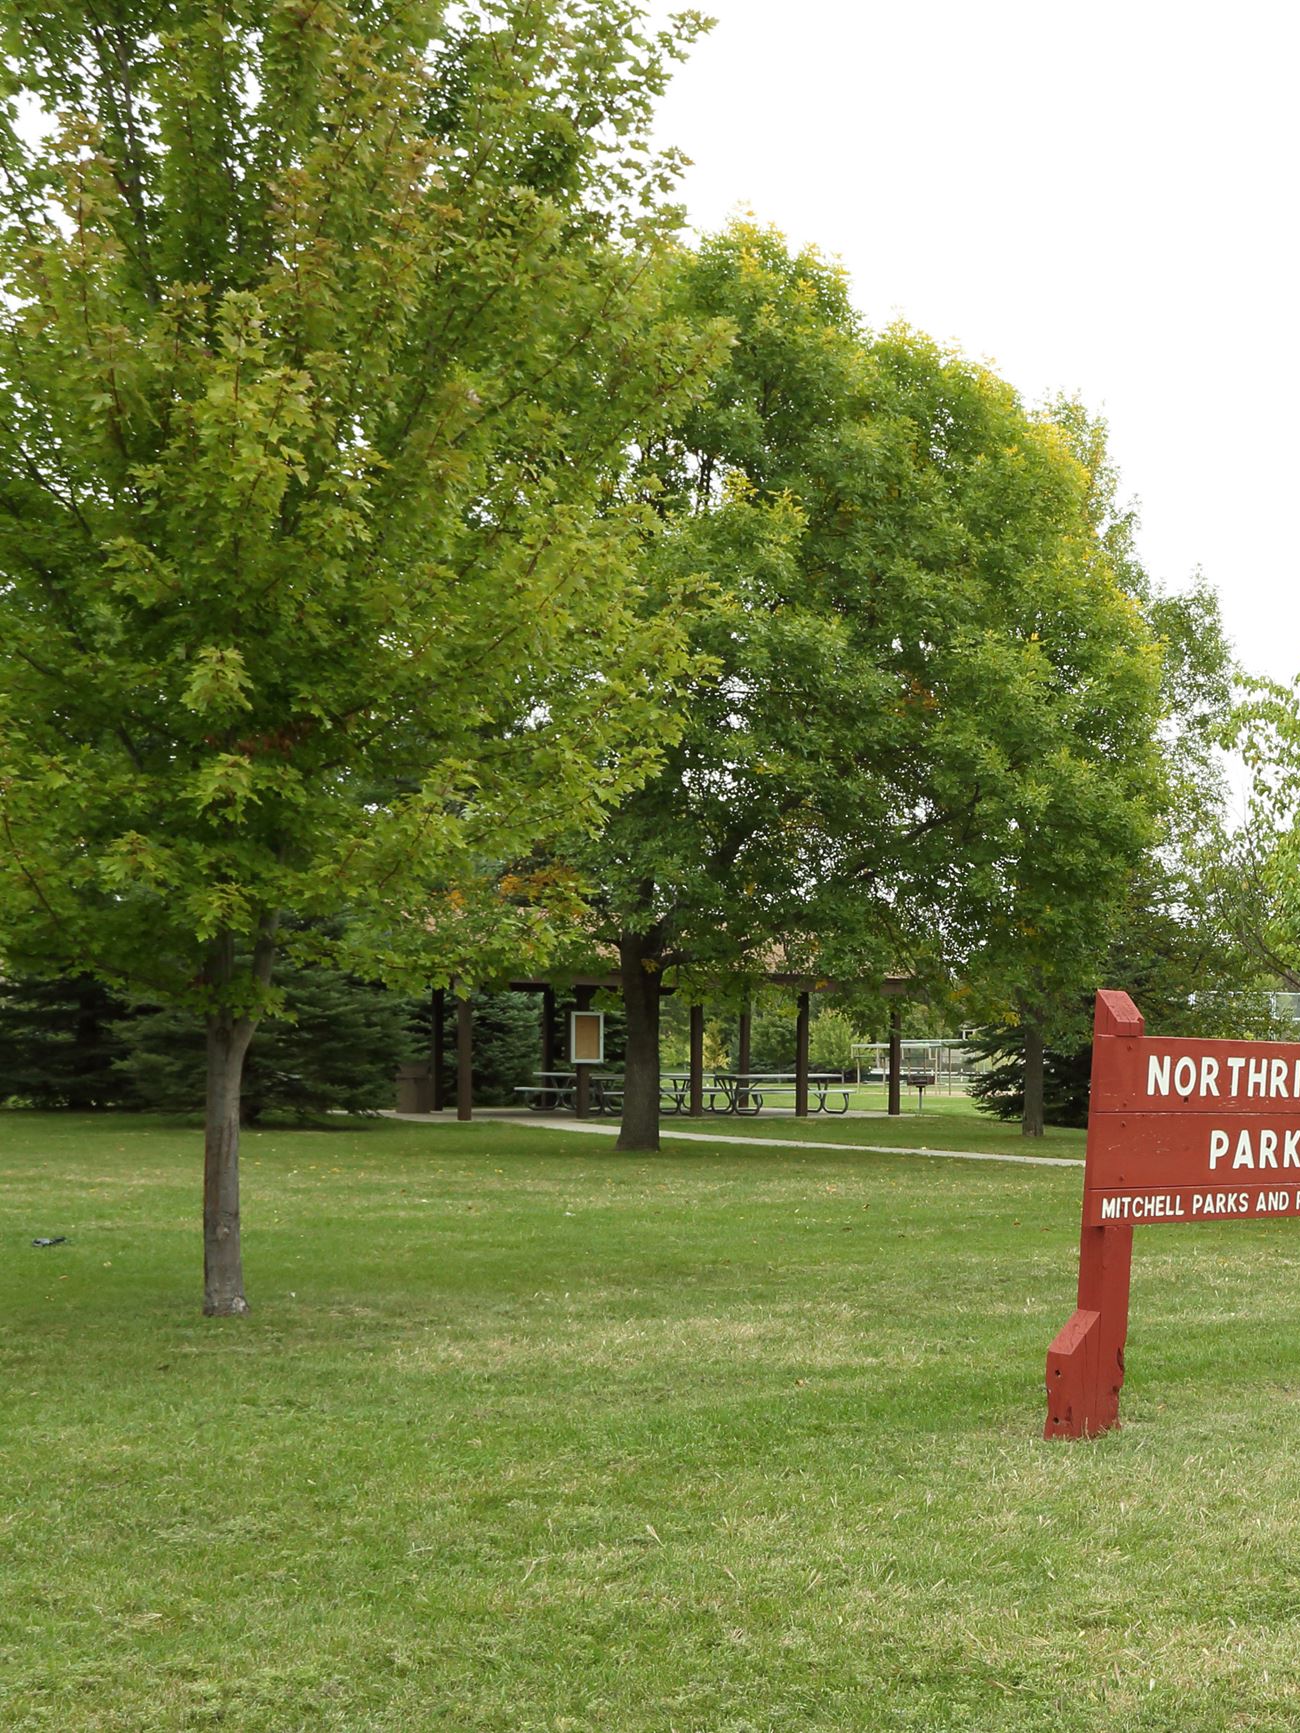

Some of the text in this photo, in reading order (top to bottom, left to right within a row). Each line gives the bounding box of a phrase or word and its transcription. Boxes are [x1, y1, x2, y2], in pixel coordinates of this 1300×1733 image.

[1101, 1195, 1185, 1220] MITCHELL
[1192, 1192, 1249, 1215] PARKS
[1255, 1190, 1289, 1213] AND
